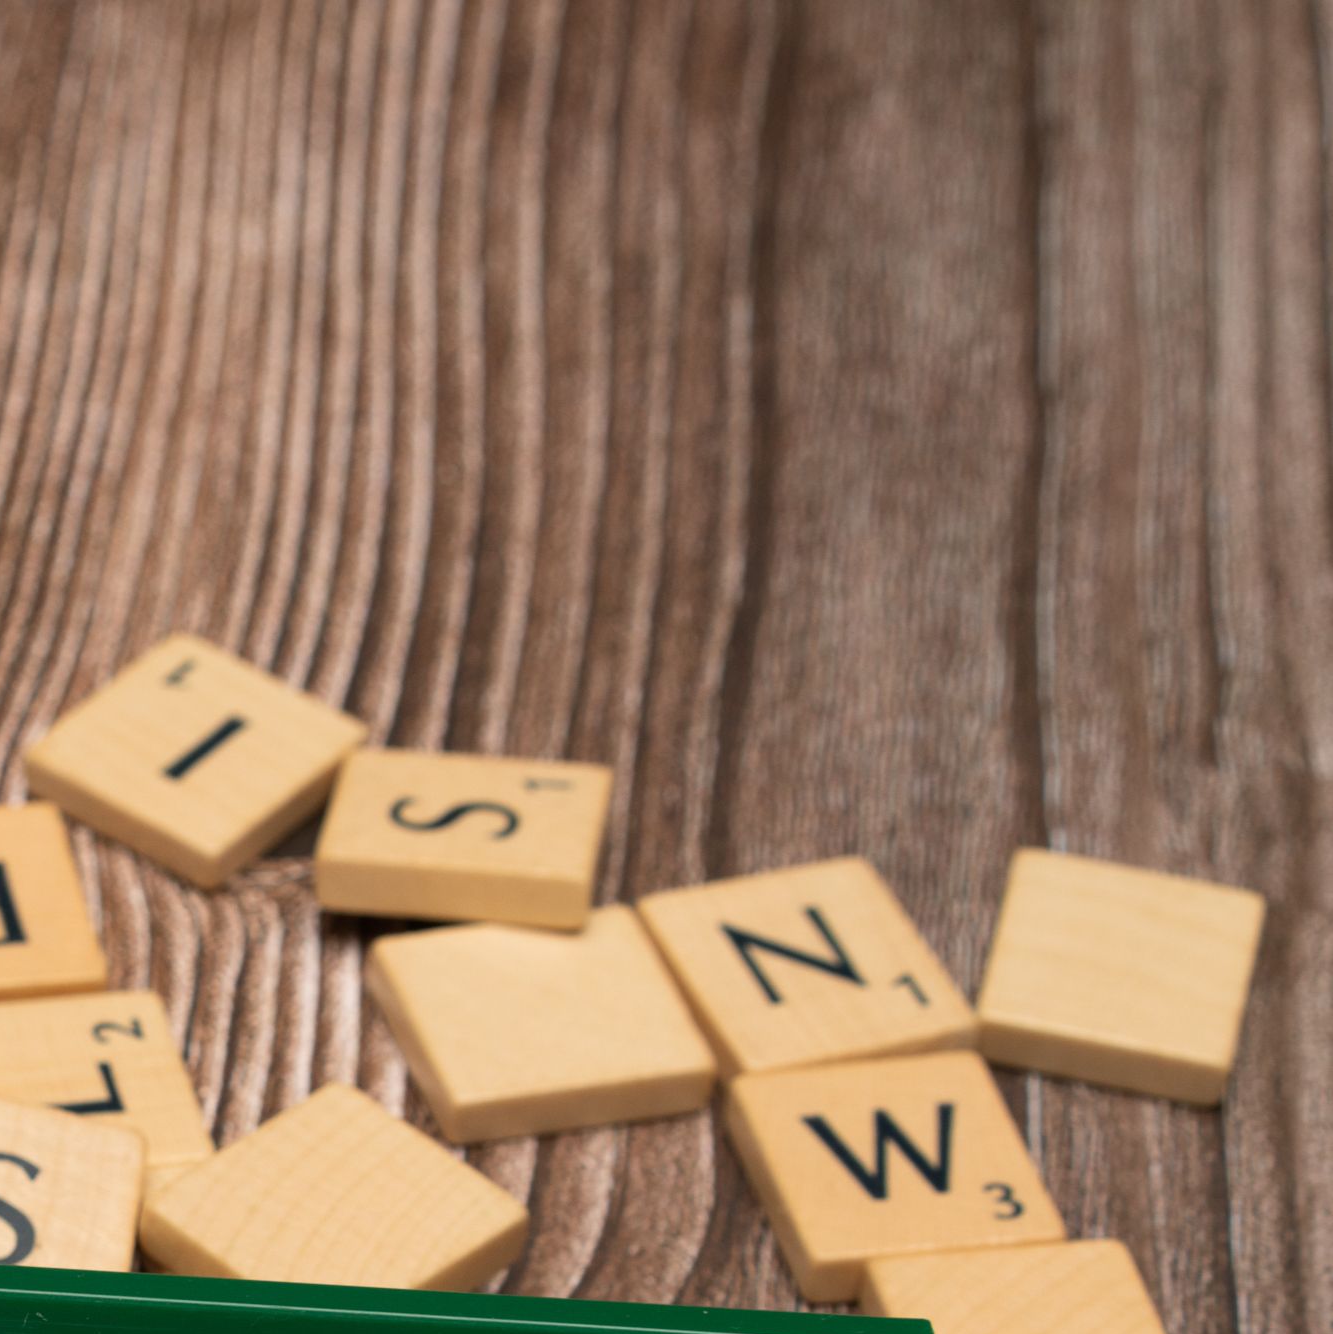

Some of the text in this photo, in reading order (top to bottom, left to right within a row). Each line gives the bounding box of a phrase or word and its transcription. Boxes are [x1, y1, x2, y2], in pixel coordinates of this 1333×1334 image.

[391, 801, 518, 836] S
[723, 908, 863, 1003] N
[804, 1104, 953, 1199] W
